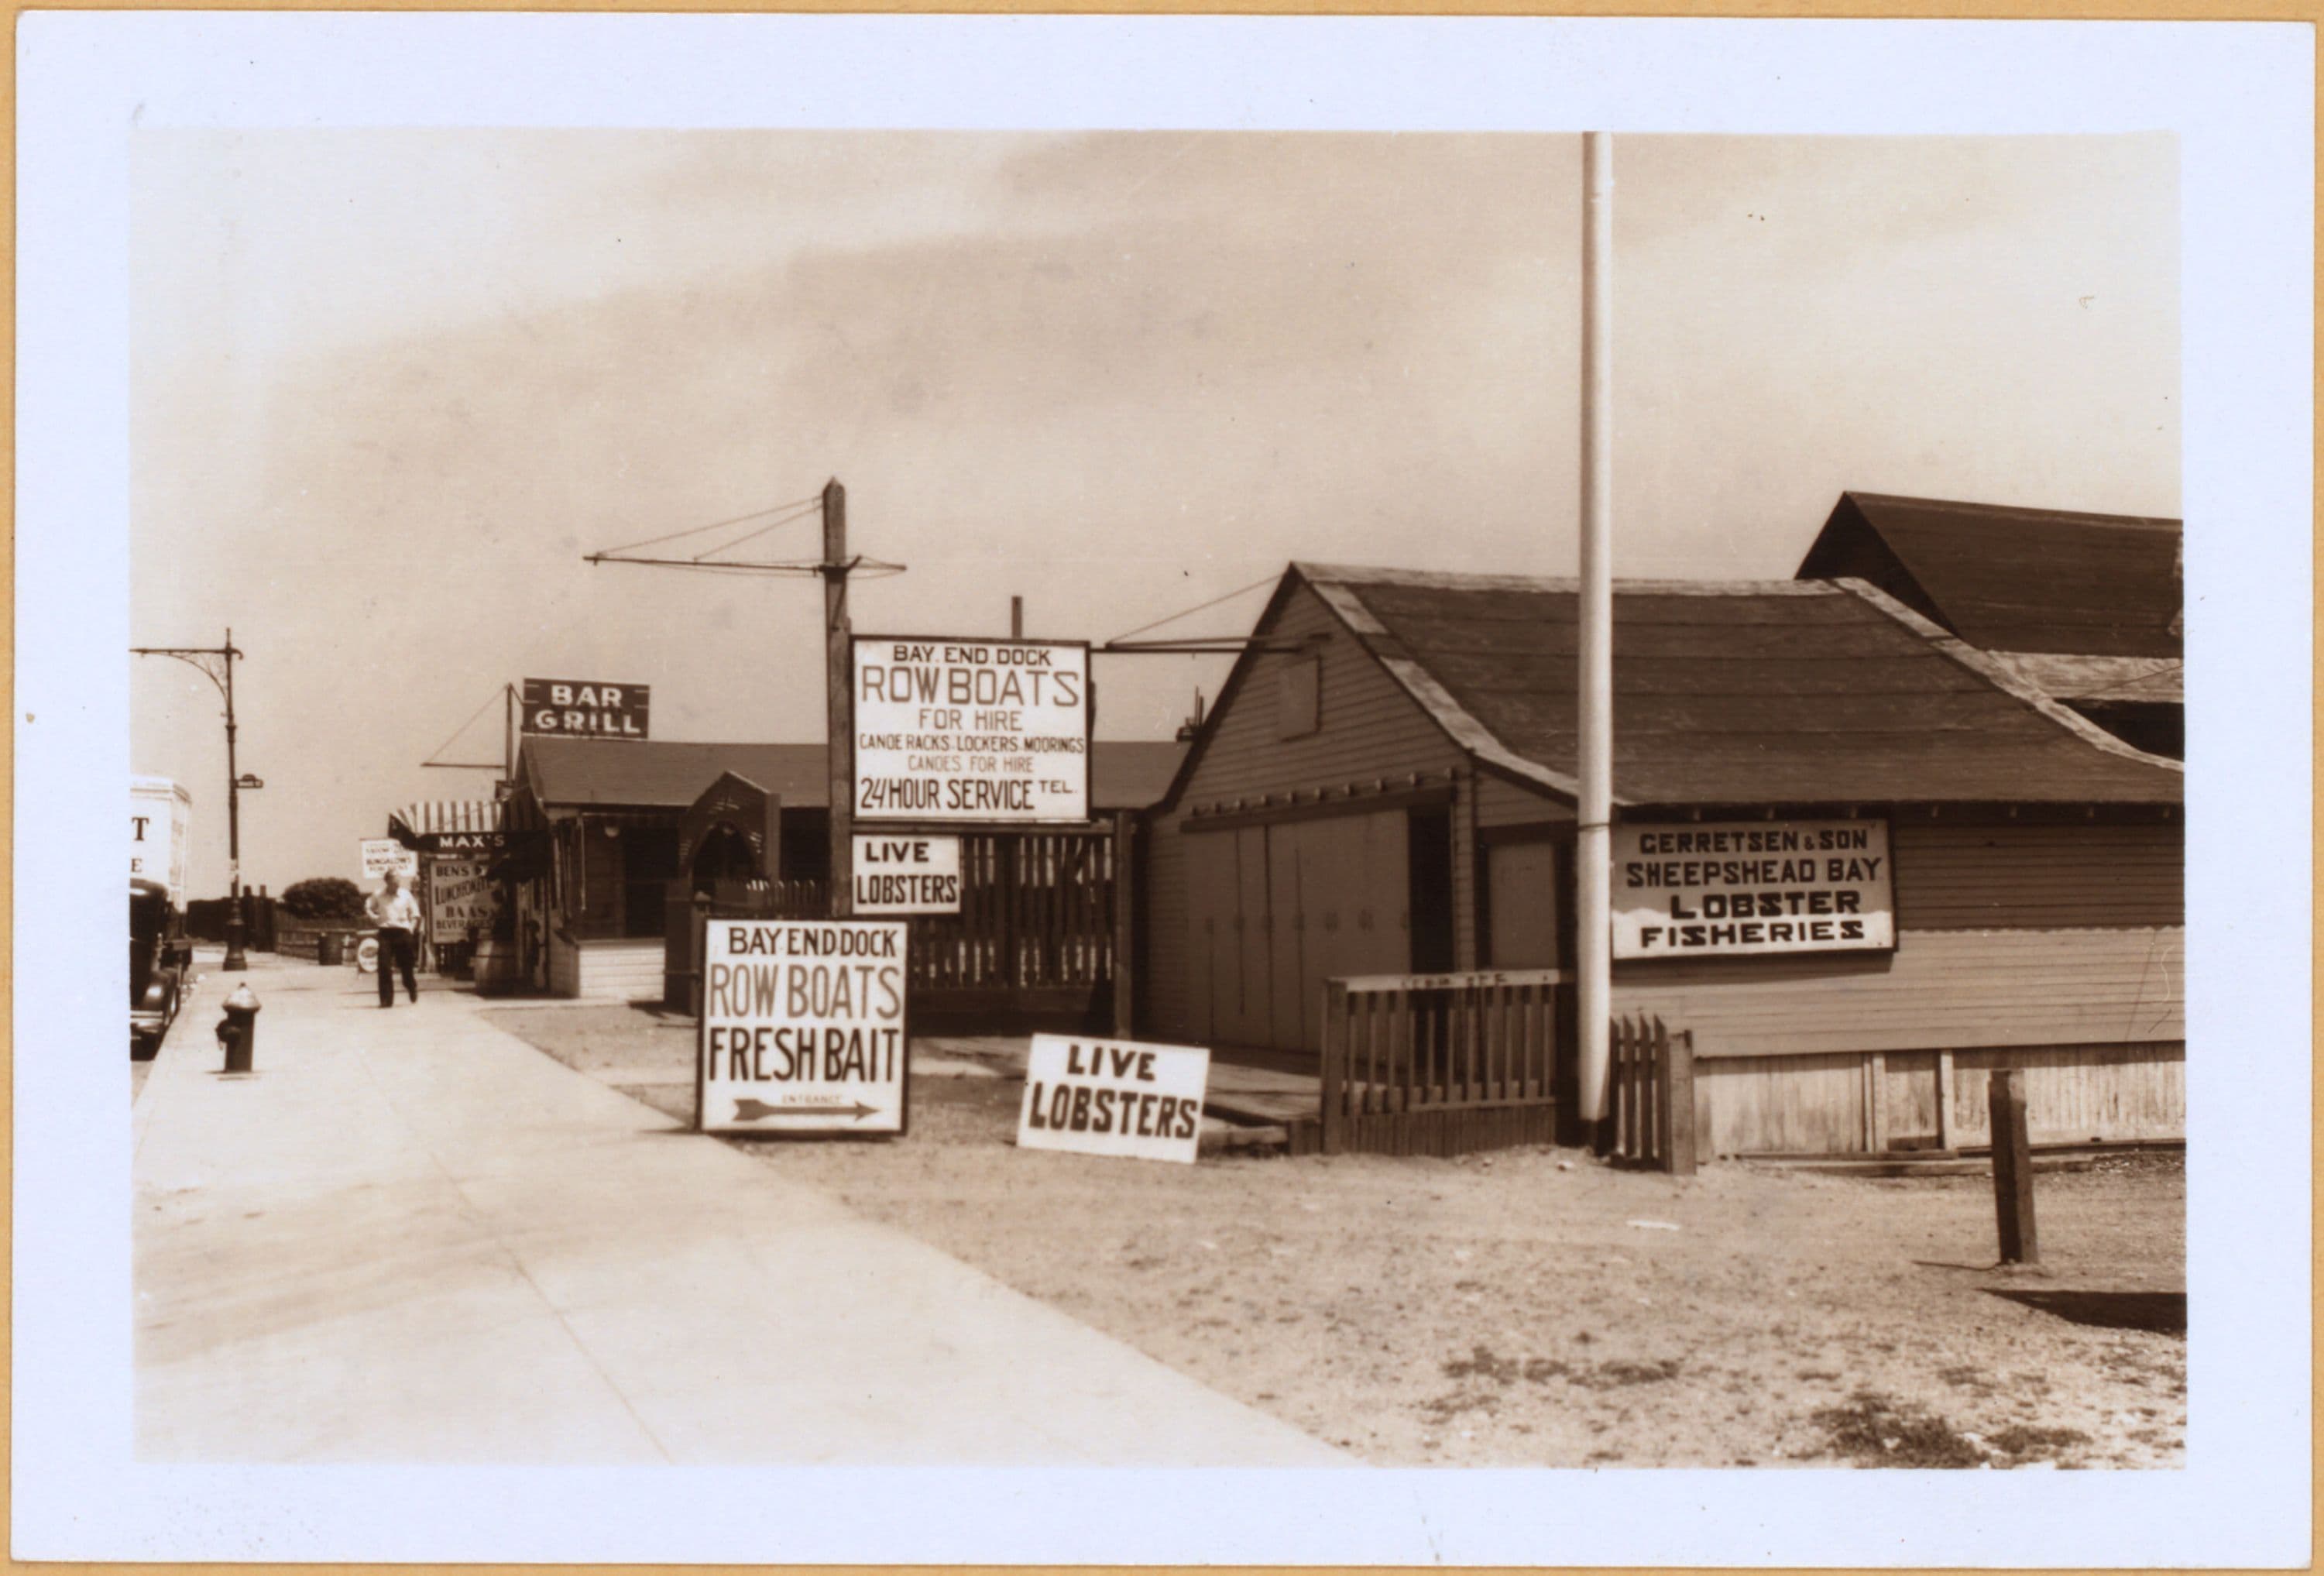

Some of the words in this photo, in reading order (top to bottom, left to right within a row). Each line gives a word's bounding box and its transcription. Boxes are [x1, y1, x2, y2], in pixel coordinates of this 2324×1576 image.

[894, 644, 935, 662] BAY
[944, 647, 989, 664] END
[997, 649, 1052, 666] DOCK
[551, 685, 623, 707] BAR
[535, 709, 640, 733] GRILL
[919, 709, 962, 730] FOR
[974, 710, 1023, 732] HIRE
[860, 733, 902, 750] CANOE
[906, 734, 950, 751] RACKS
[956, 736, 1019, 752] LOCKERS
[1024, 736, 1084, 754] MOORINGS
[907, 755, 961, 772] CANOES
[970, 756, 997, 772] FOR
[1004, 757, 1034, 773] HIRE
[947, 778, 1035, 810] SERVICE
[1038, 780, 1079, 794] TEL.
[439, 836, 505, 848] MAX'S
[865, 842, 929, 863] LIVE
[1640, 832, 1799, 854] GERRETSEN
[1804, 835, 1814, 850] &
[1820, 829, 1867, 850] SON
[1626, 858, 1816, 888] SHEEPSHEAD
[1826, 857, 1883, 882] BAY
[856, 874, 958, 905] LOBSTERS
[1670, 891, 1860, 920] LOBSTER
[728, 927, 781, 955] BAY
[787, 929, 836, 957] END
[840, 929, 898, 958] DOCK
[1640, 920, 1865, 949] FISHERIES
[709, 963, 779, 1018] ROW
[787, 964, 901, 1021] BOATS
[709, 1026, 815, 1082] FRESH
[824, 1027, 899, 1083] BAIT
[1067, 1045, 1156, 1081] LIVE
[1028, 1081, 1198, 1139] LOBSTERS
